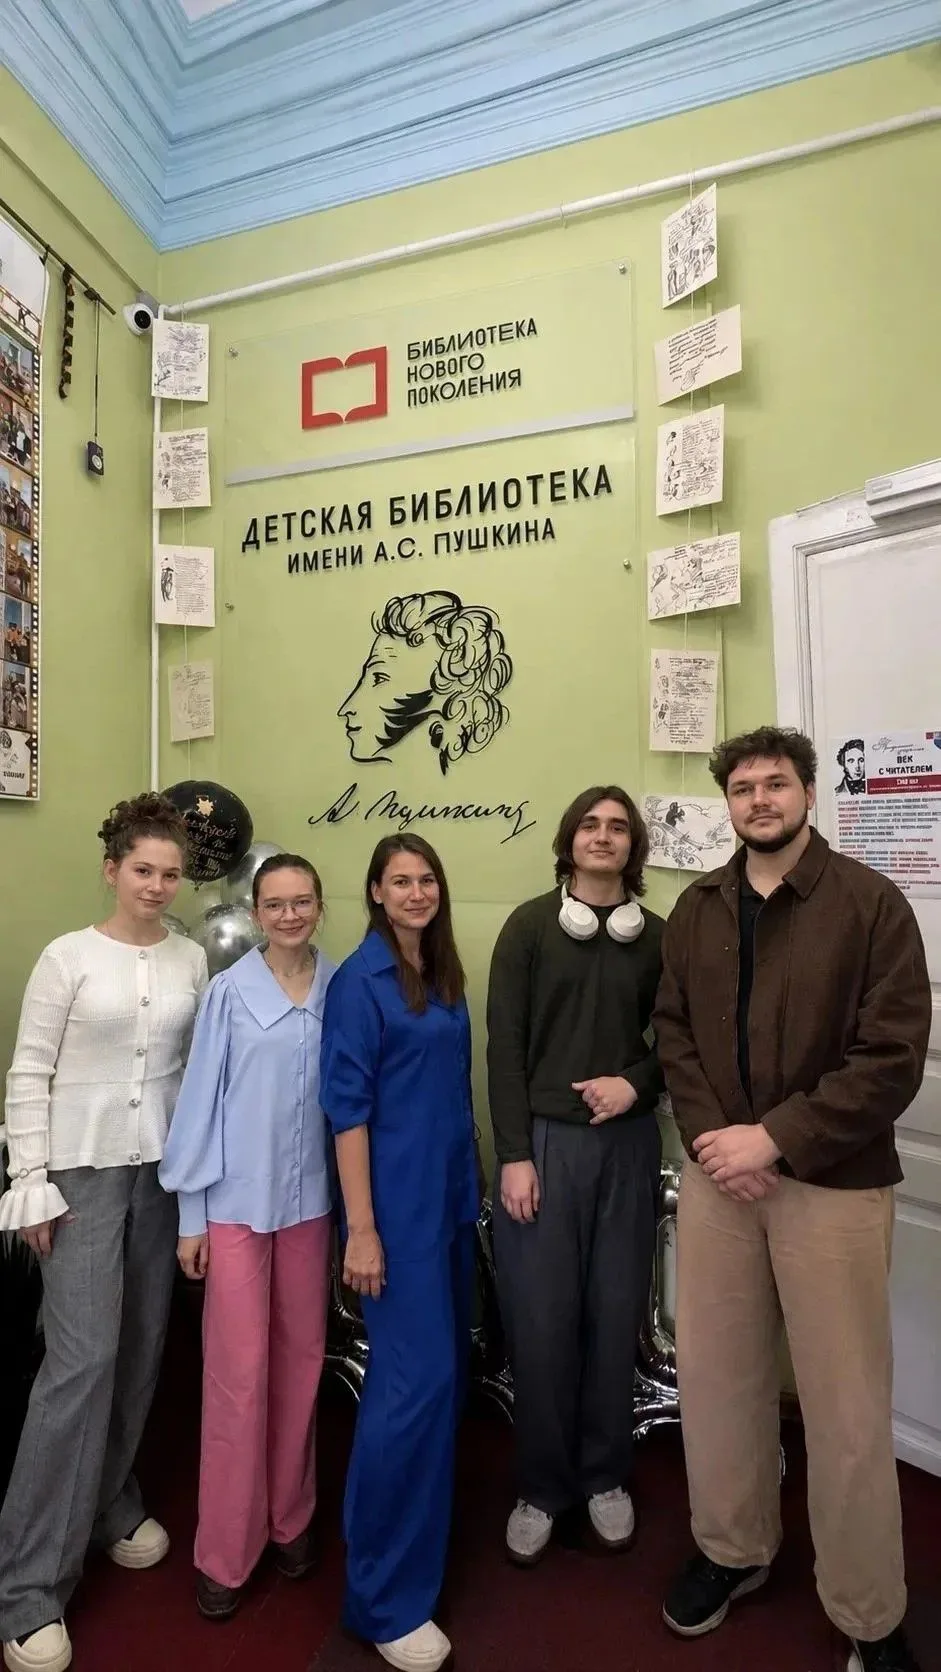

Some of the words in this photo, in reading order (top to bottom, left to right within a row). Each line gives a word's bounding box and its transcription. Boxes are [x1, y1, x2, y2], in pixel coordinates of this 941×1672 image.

[408, 318, 537, 360] БИБЛИОТЕКА
[408, 353, 485, 384] НОВОГО
[408, 368, 521, 407] ПОКОЛЕНИЯ
[241, 500, 372, 553] ДЕТСКАЯ
[389, 464, 612, 526] БИБЛИОТЕКА
[288, 544, 363, 574] ИМЕНИ
[373, 537, 423, 563] А.С.
[434, 517, 555, 554] ПУШКИНА
[886, 765, 933, 775] ЧИТАТЕЛЕМ
